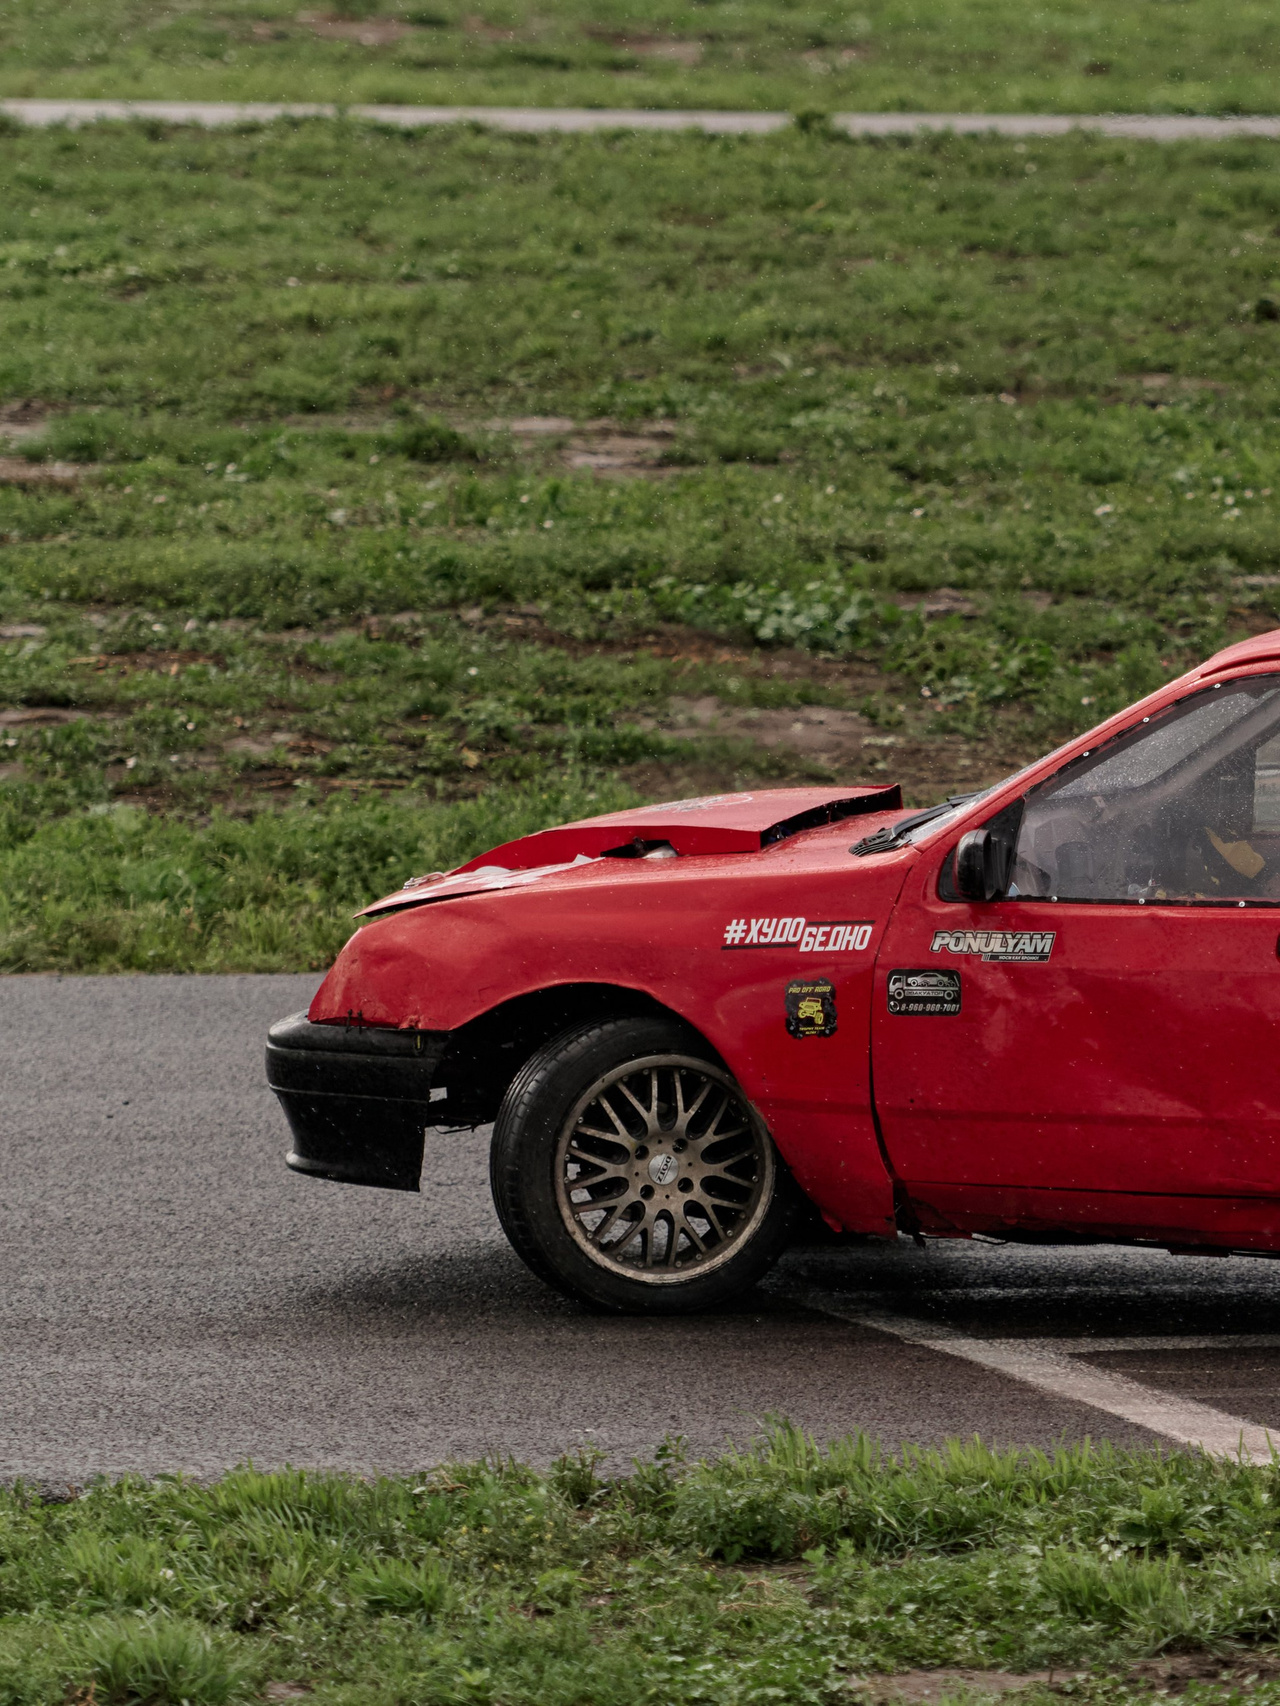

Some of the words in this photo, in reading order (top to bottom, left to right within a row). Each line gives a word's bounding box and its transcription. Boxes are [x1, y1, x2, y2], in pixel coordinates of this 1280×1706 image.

[723, 917, 806, 945] #ХУДО
[799, 925, 873, 952] БЕДНО
[931, 931, 1055, 953] PONULYAM
[900, 1003, 960, 1012] 8-960-960-7001
[657, 1155, 672, 1183] DOTZ
